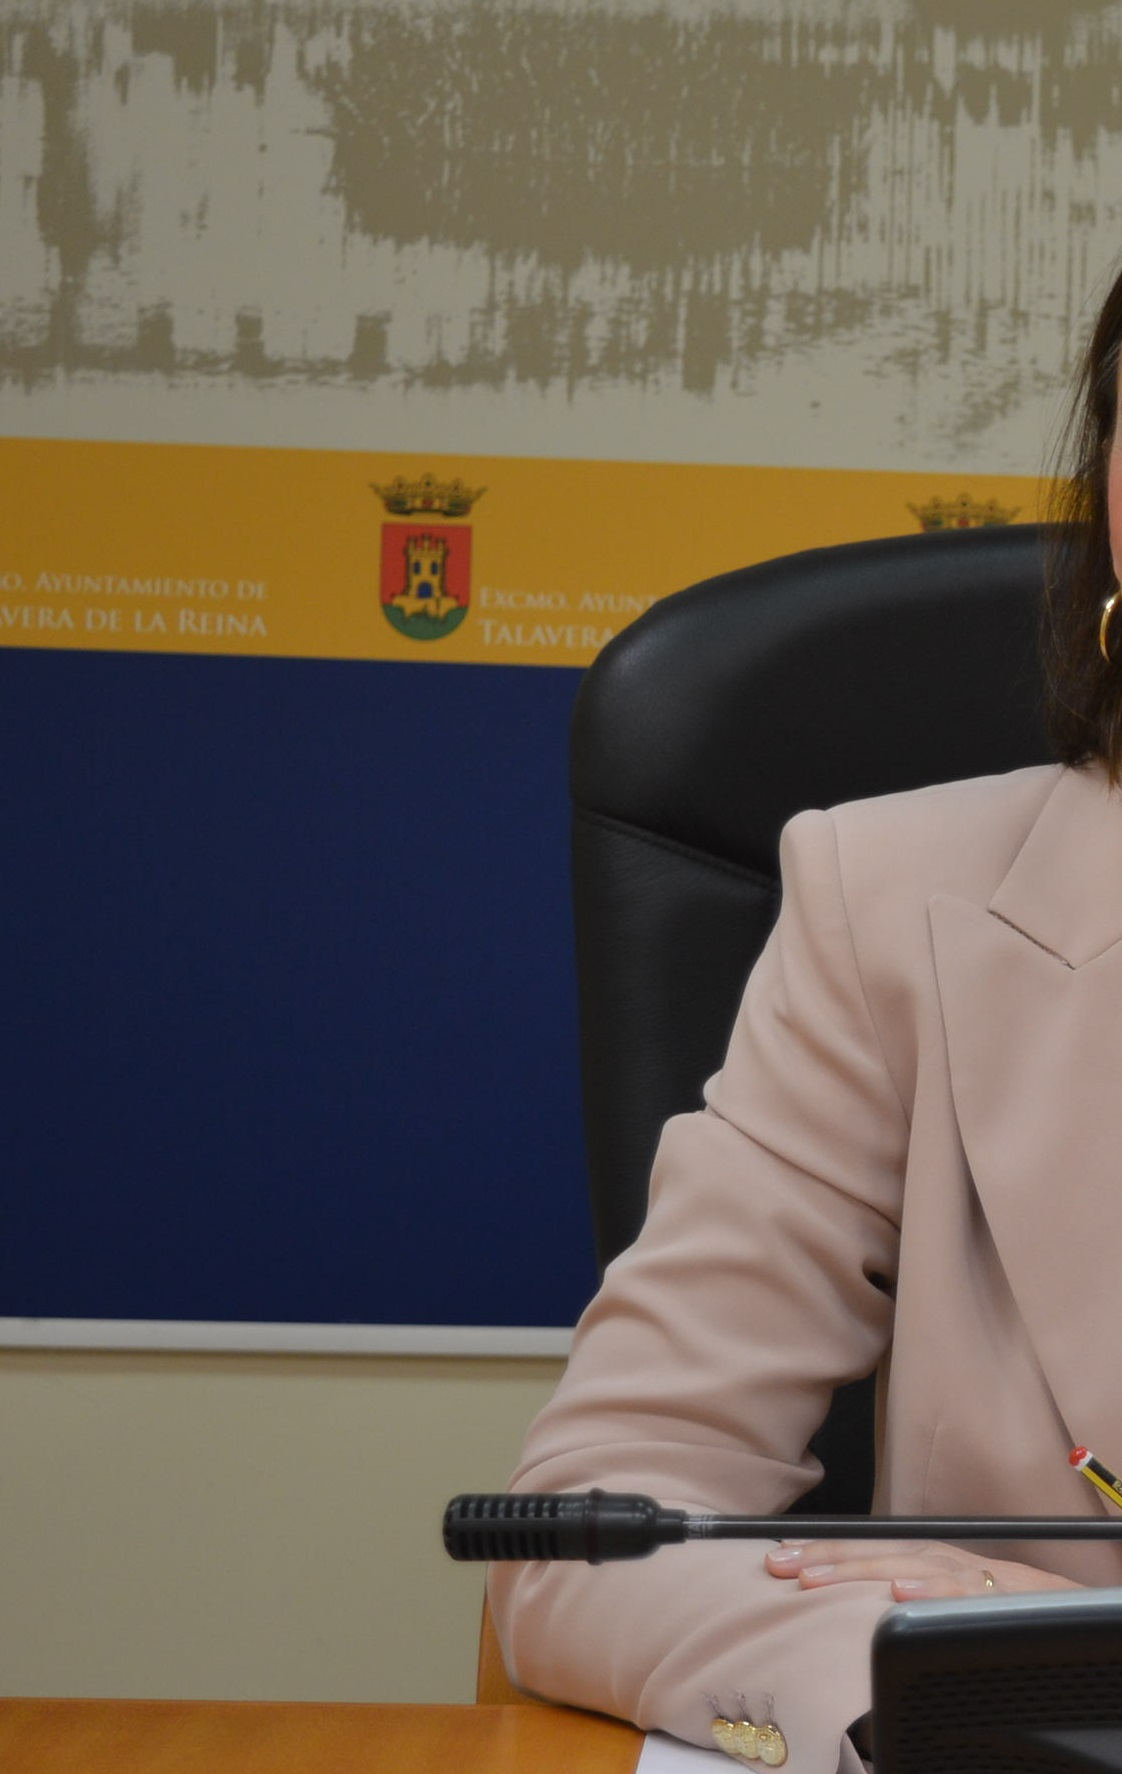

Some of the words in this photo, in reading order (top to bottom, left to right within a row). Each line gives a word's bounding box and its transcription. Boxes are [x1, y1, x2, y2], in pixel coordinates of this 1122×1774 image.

[35, 570, 229, 599] AYUNTAMIENTO
[237, 580, 270, 601] DE
[84, 607, 121, 632] DE
[133, 609, 167, 634] LA
[178, 607, 268, 638] REINA
